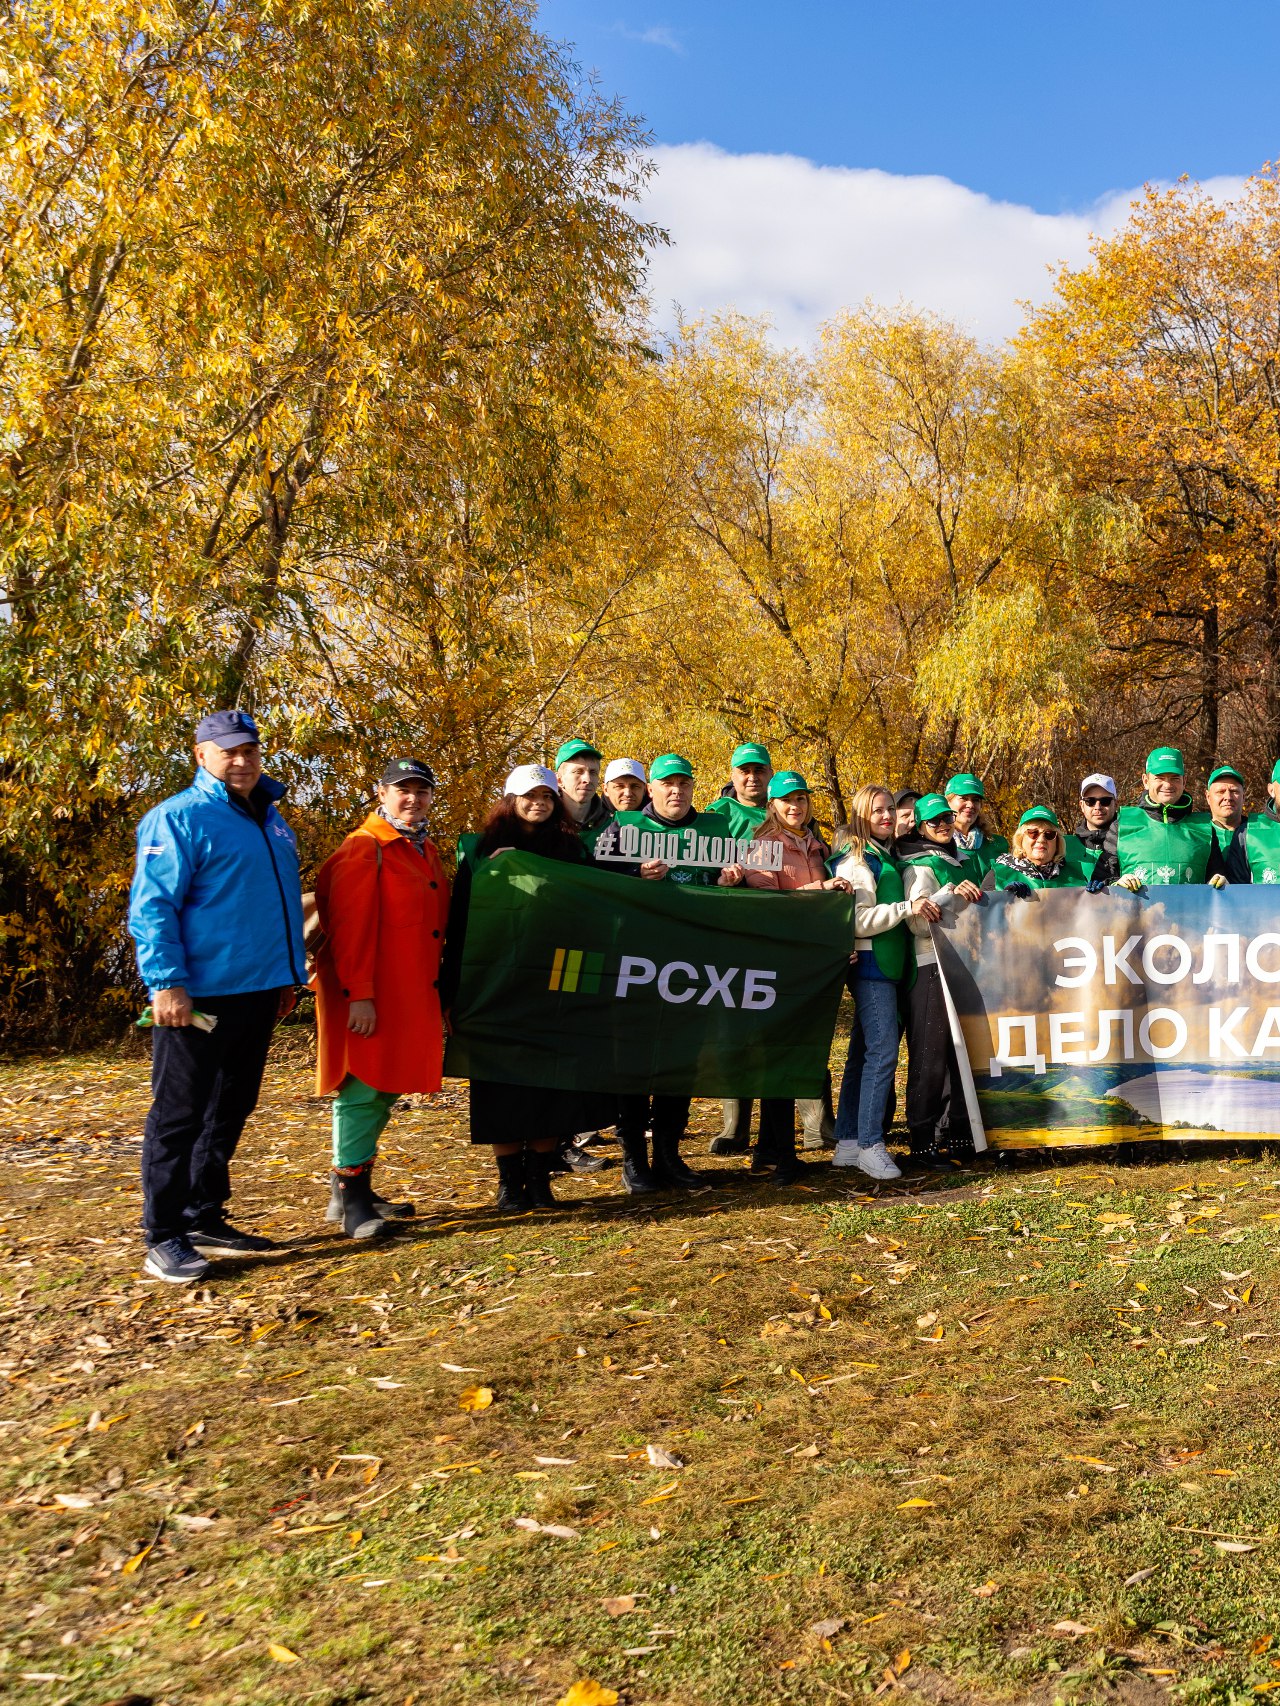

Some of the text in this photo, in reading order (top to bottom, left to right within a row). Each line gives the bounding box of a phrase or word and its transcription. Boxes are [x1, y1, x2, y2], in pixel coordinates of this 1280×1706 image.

[595, 824, 679, 867] #Фонд
[615, 955, 777, 1010] РСХБ
[990, 1007, 1188, 1077] ДЕЛО
